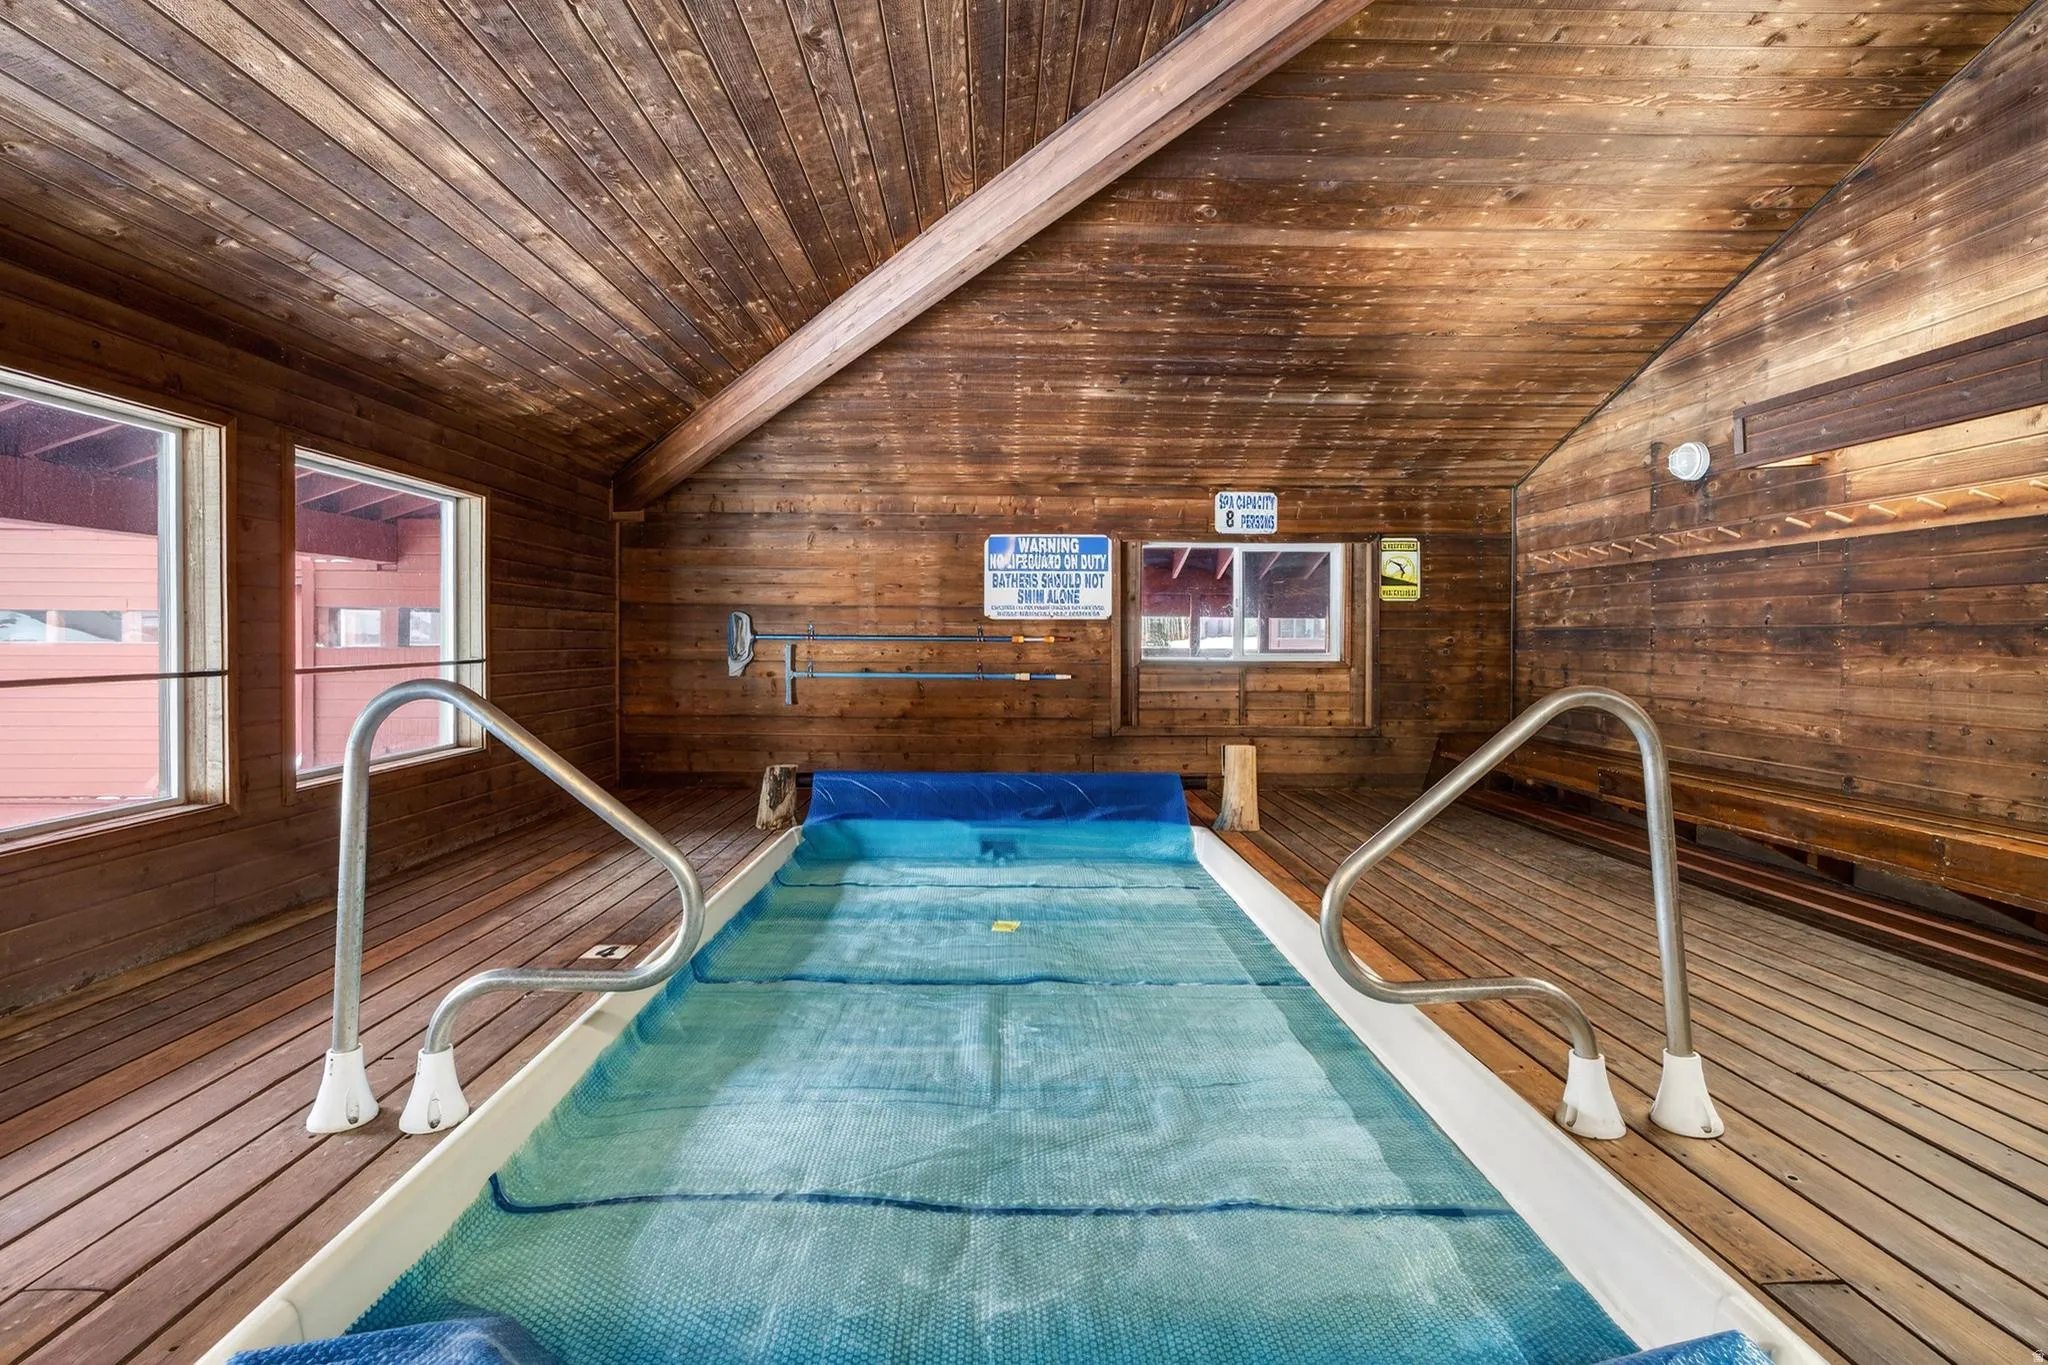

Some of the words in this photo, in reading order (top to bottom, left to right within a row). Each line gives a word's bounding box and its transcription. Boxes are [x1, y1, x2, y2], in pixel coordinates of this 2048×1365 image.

[1236, 495, 1275, 510] CAPACITY
[1226, 510, 1235, 528] 8
[1241, 515, 1275, 530] PERSONS
[1017, 538, 1080, 554] WARNING
[989, 553, 1007, 570] NO
[1007, 553, 1061, 570] LIFEGUARD
[1063, 554, 1079, 570] ON
[1080, 554, 1107, 570] DUTY
[992, 573, 1039, 589] BATHERS
[1041, 573, 1082, 589] SHOULD
[1084, 573, 1105, 589] NOT
[1017, 589, 1045, 605] SWIM
[1046, 589, 1080, 605] ALONE
[595, 945, 620, 958] 4
